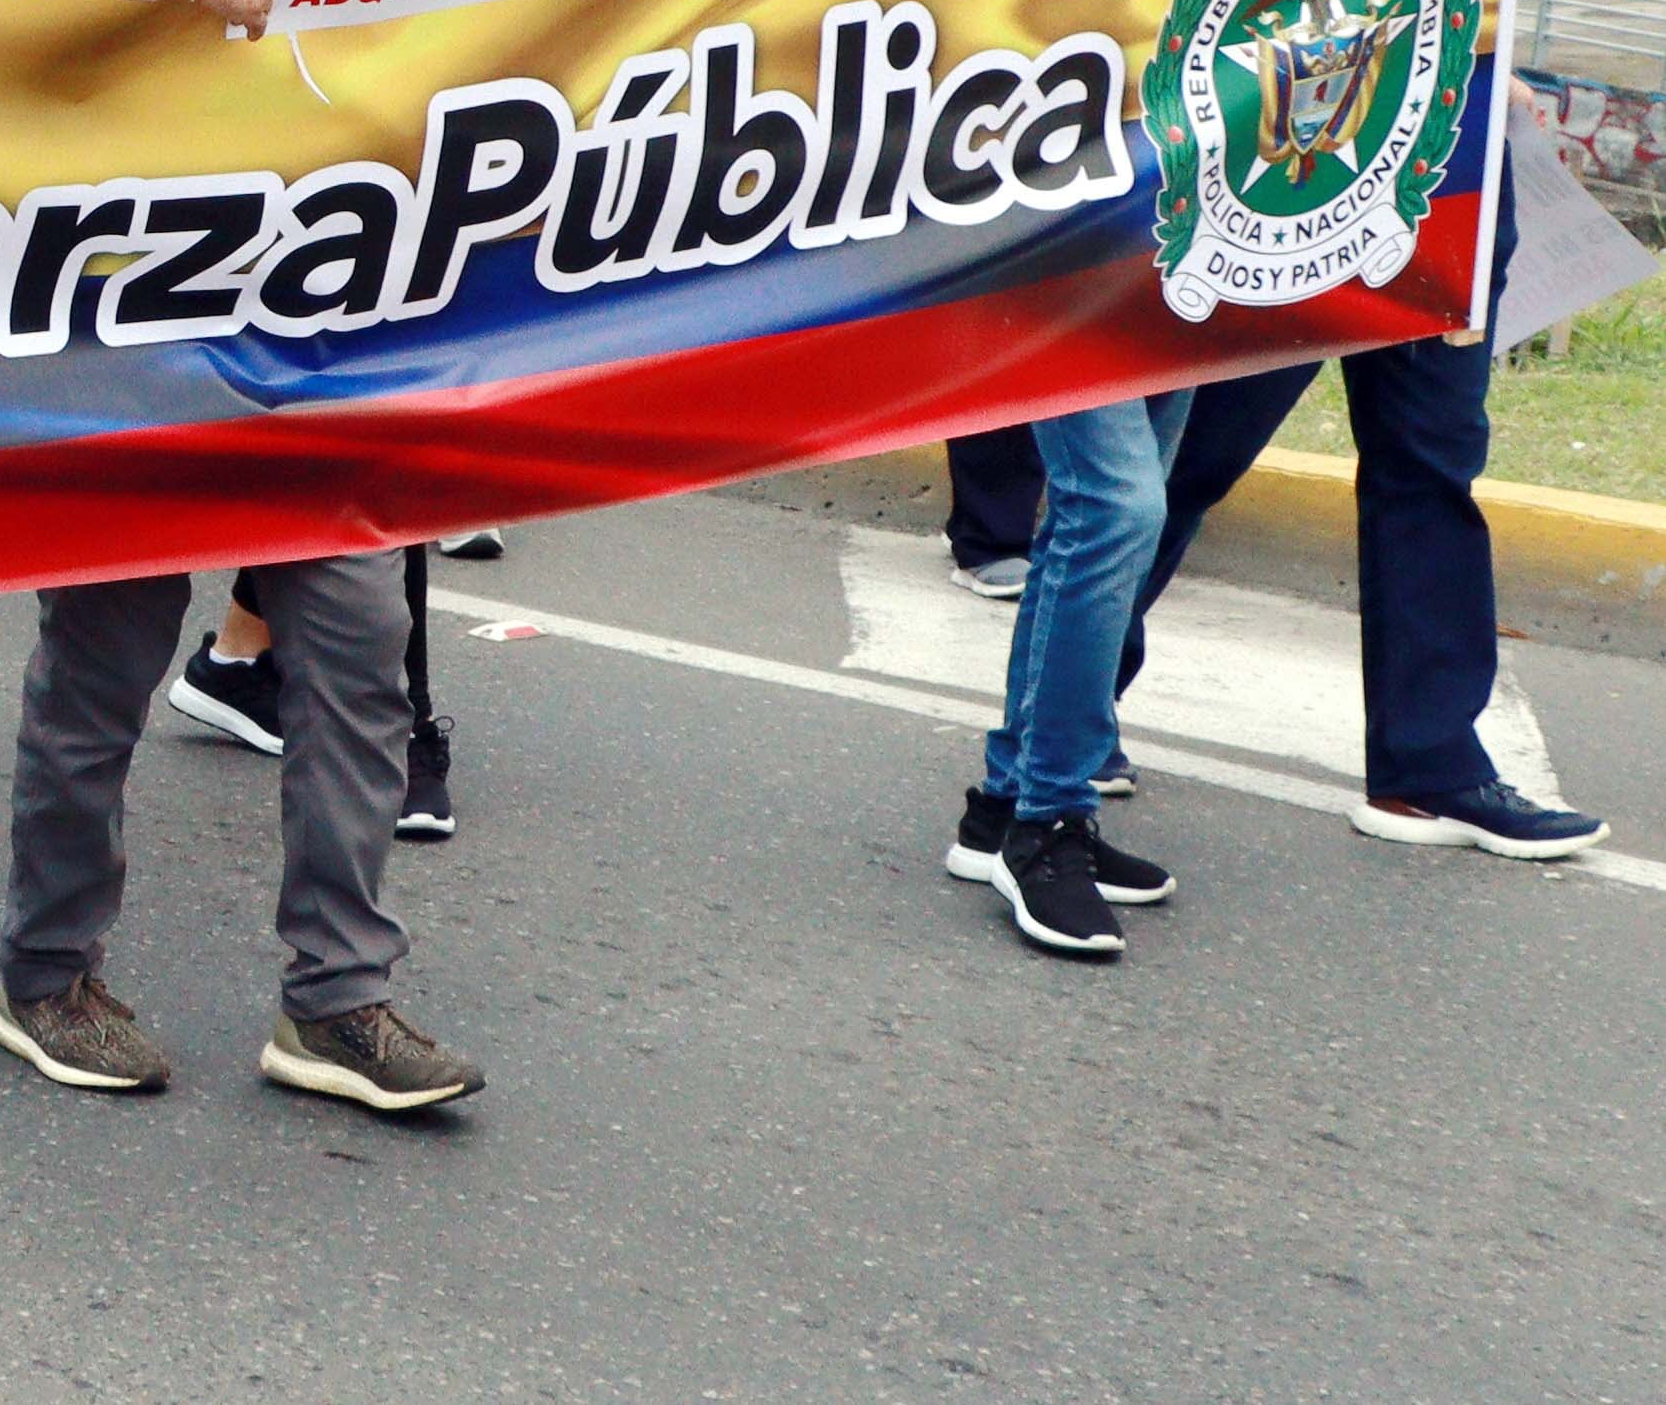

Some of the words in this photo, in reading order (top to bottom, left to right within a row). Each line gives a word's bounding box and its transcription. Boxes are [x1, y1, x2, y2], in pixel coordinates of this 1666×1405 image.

[1203, 161, 1264, 245] POLICÍA
[1295, 111, 1420, 241] NACIONAL
[1291, 225, 1379, 286] PATRIA
